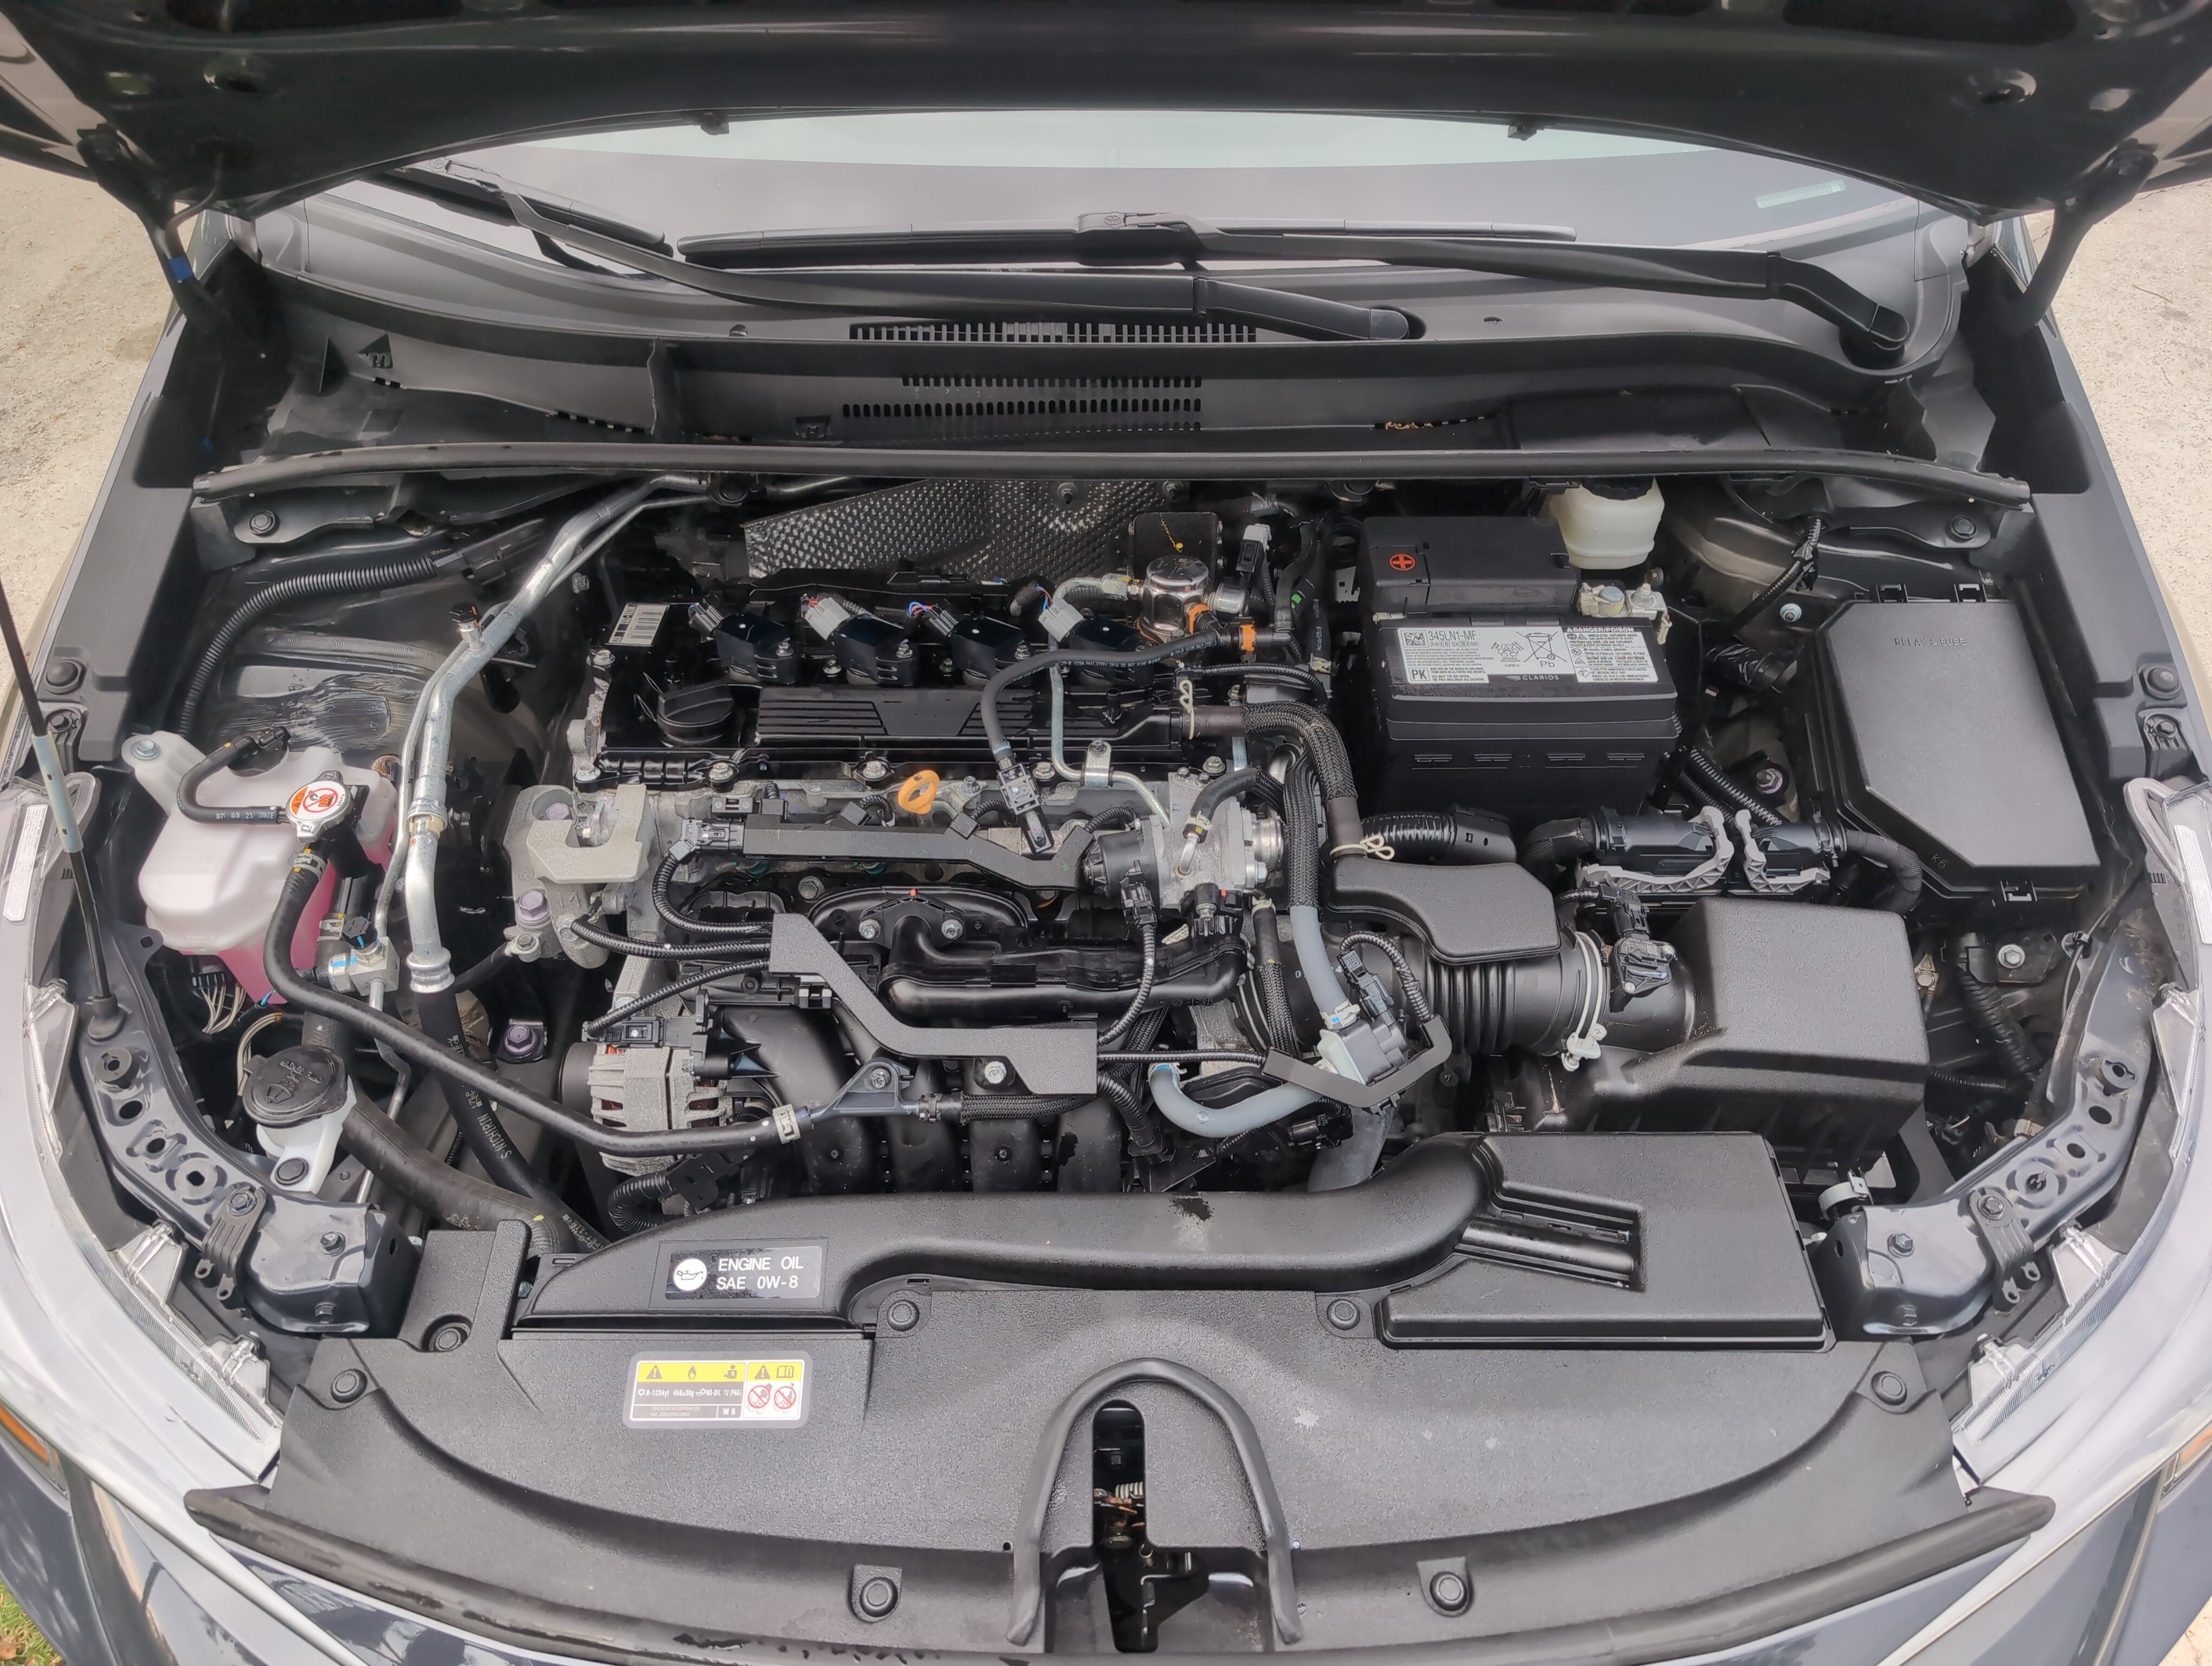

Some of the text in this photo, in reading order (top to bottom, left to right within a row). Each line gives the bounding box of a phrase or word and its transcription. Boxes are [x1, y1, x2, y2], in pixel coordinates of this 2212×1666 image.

[1428, 630, 1477, 641] 345LN1-MF
[1930, 638, 1938, 646] &
[1939, 638, 1967, 646] FUSE
[1411, 670, 1427, 680] PK
[718, 1256, 804, 1271] ENGINE OIL
[716, 1275, 799, 1290] SAE 0W-8
[646, 1389, 670, 1398] R-1234yf
[730, 1389, 742, 1397] (PAG)
